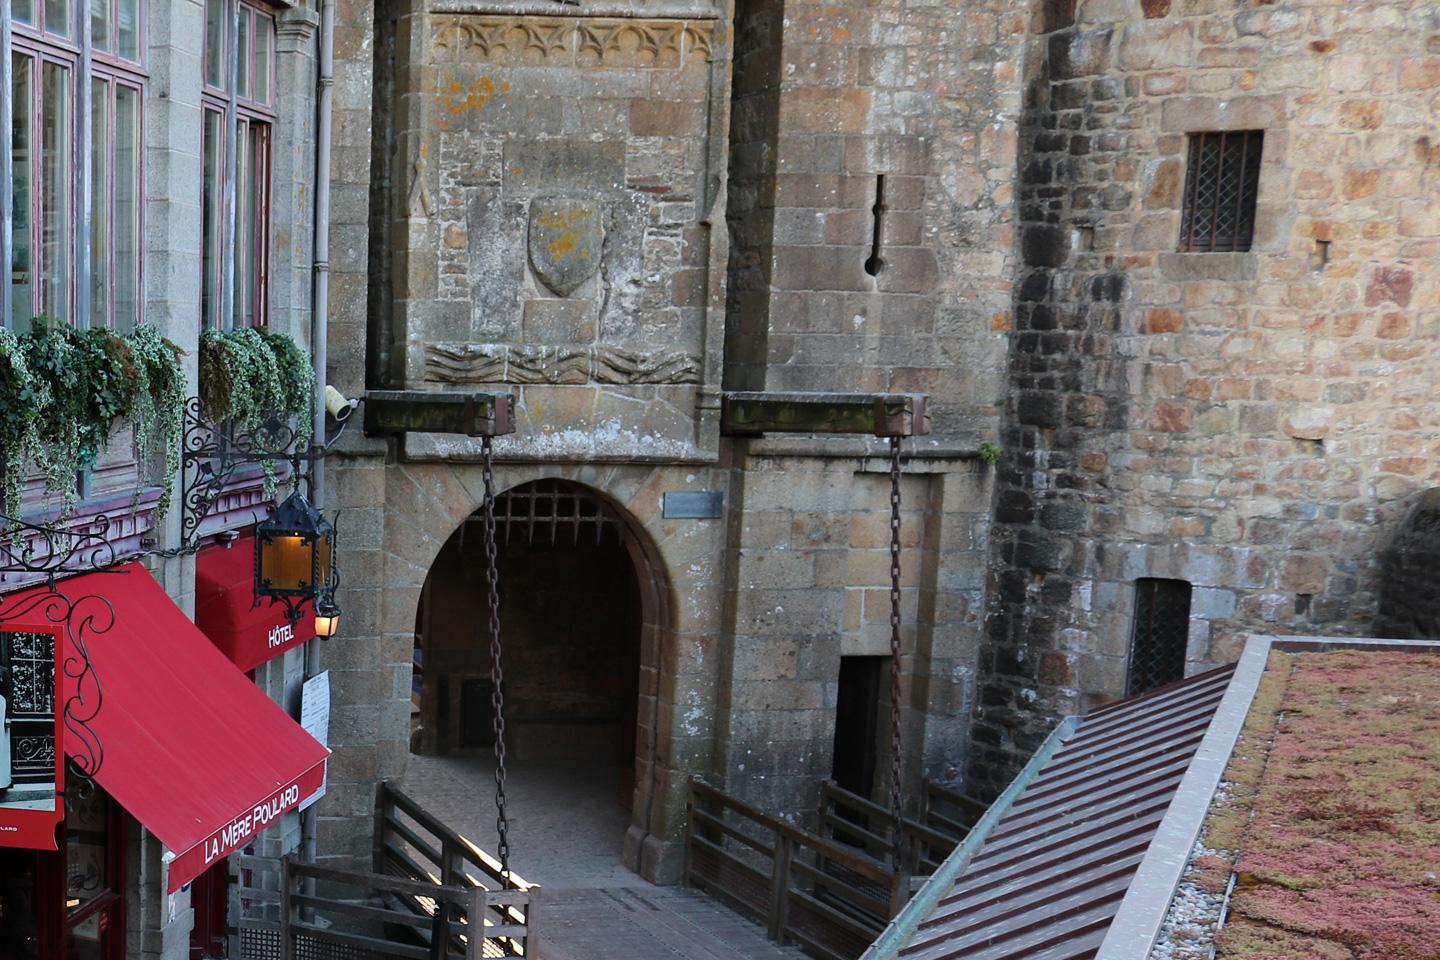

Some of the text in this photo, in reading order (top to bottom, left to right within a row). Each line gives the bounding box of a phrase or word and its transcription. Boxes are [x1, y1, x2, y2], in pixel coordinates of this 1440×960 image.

[268, 624, 295, 649] HÔTEL
[204, 784, 299, 864] LA MÈRE POULARD
